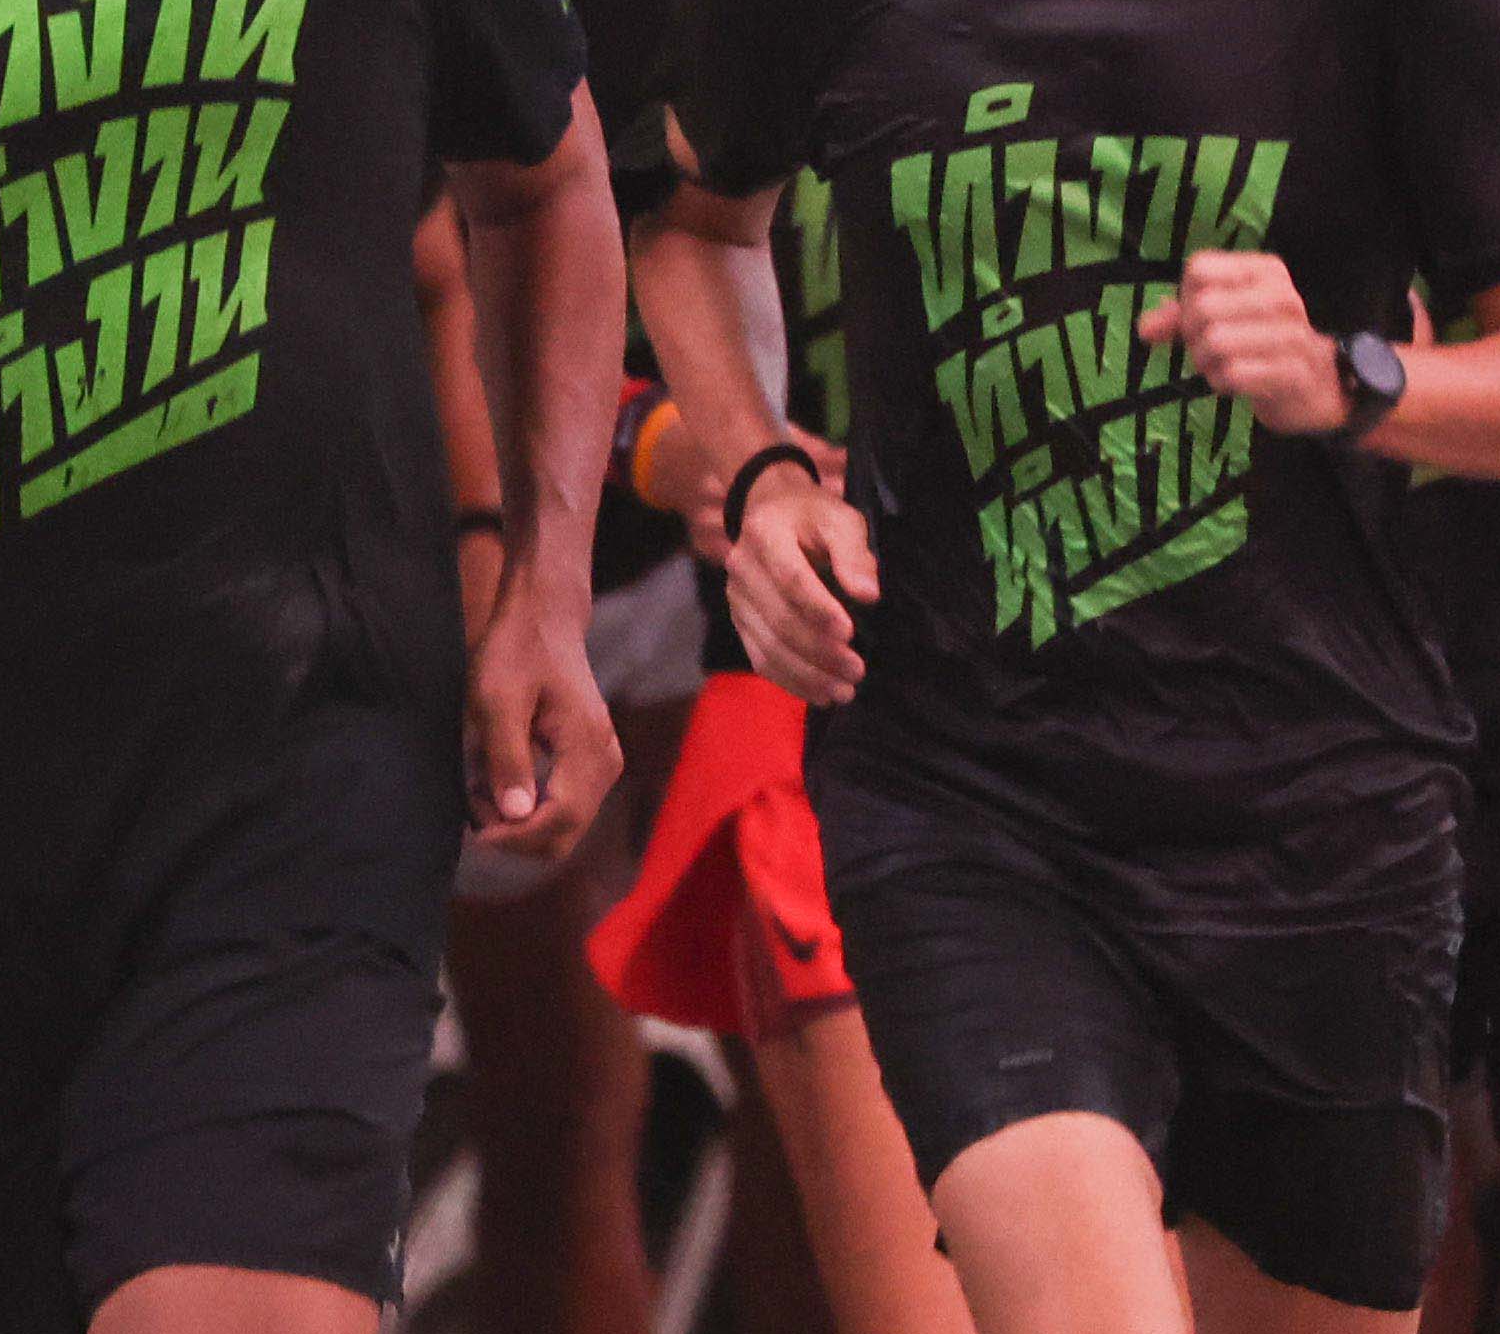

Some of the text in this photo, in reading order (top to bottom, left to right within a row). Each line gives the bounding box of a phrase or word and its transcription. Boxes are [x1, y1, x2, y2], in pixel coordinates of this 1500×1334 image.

[889, 81, 1291, 332] ทำงาน
[935, 279, 1200, 482] ทำงา
[977, 395, 1256, 651] ทำงาน
